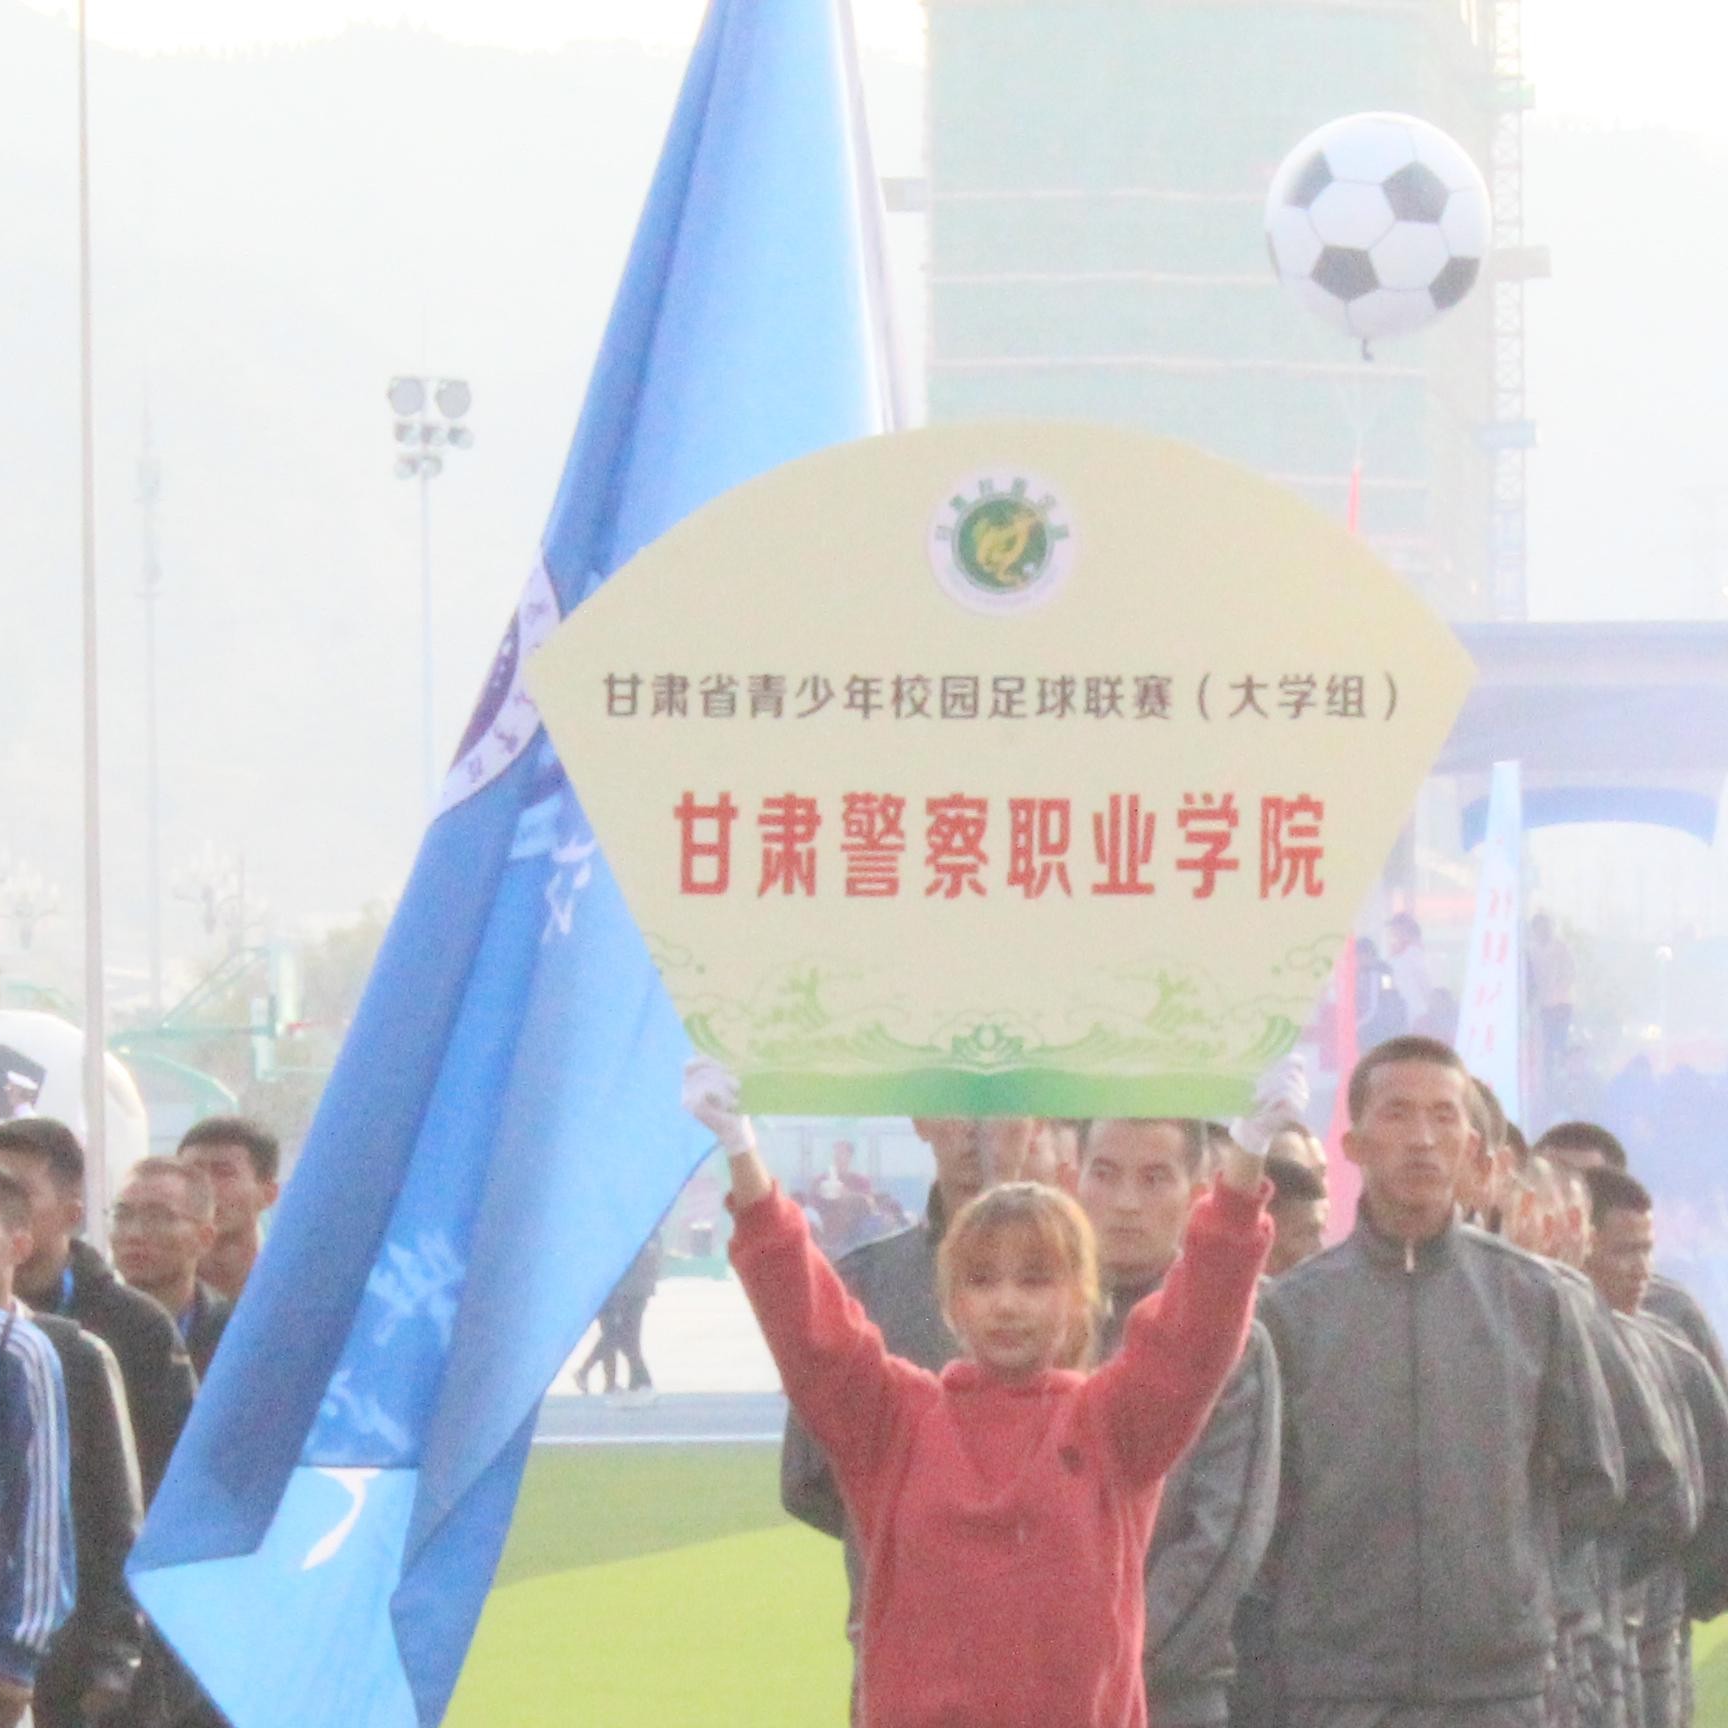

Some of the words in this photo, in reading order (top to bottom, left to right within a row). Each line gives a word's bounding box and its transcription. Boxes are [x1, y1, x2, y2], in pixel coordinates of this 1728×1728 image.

[673, 790, 1325, 900] 甘肃警察职业学院
